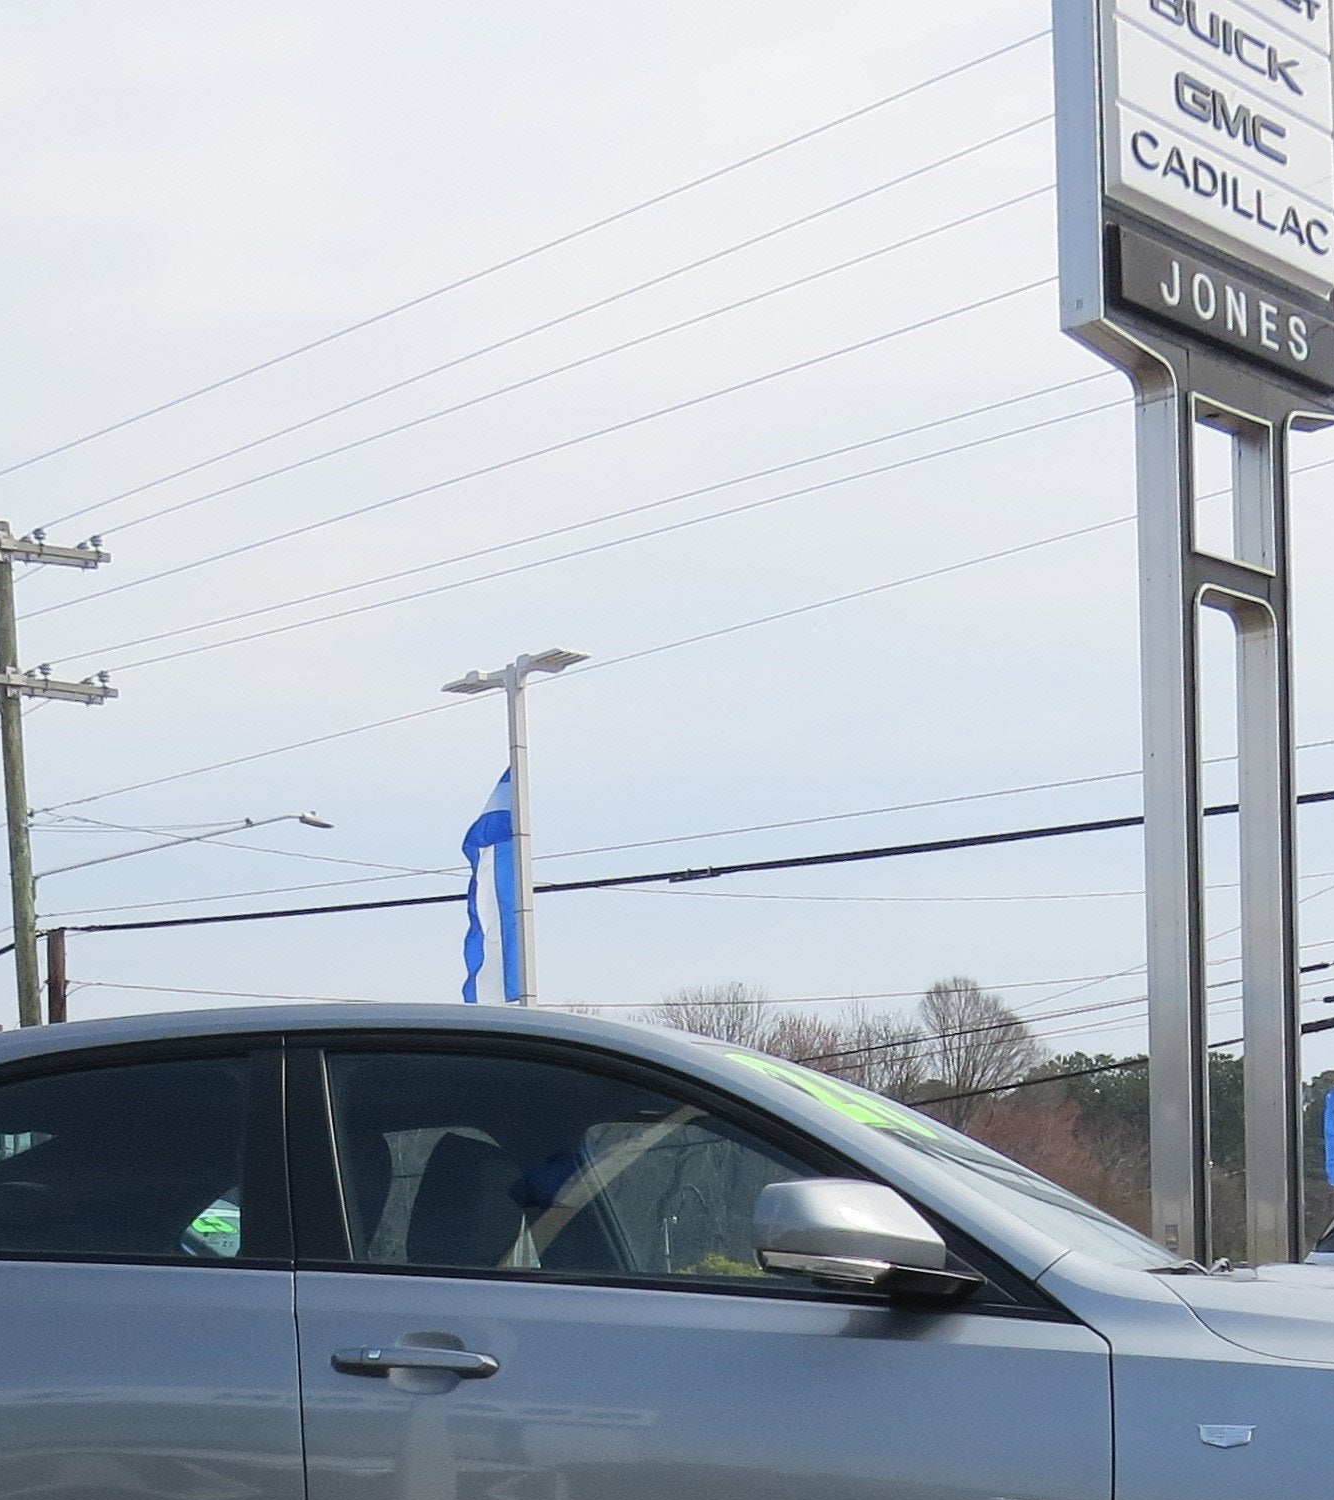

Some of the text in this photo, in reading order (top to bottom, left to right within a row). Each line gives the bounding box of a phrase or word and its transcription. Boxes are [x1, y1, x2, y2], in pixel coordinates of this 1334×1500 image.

[1174, 71, 1288, 165] GMC
[1131, 129, 1330, 255] CADILLAC
[1160, 260, 1310, 362] JONES
